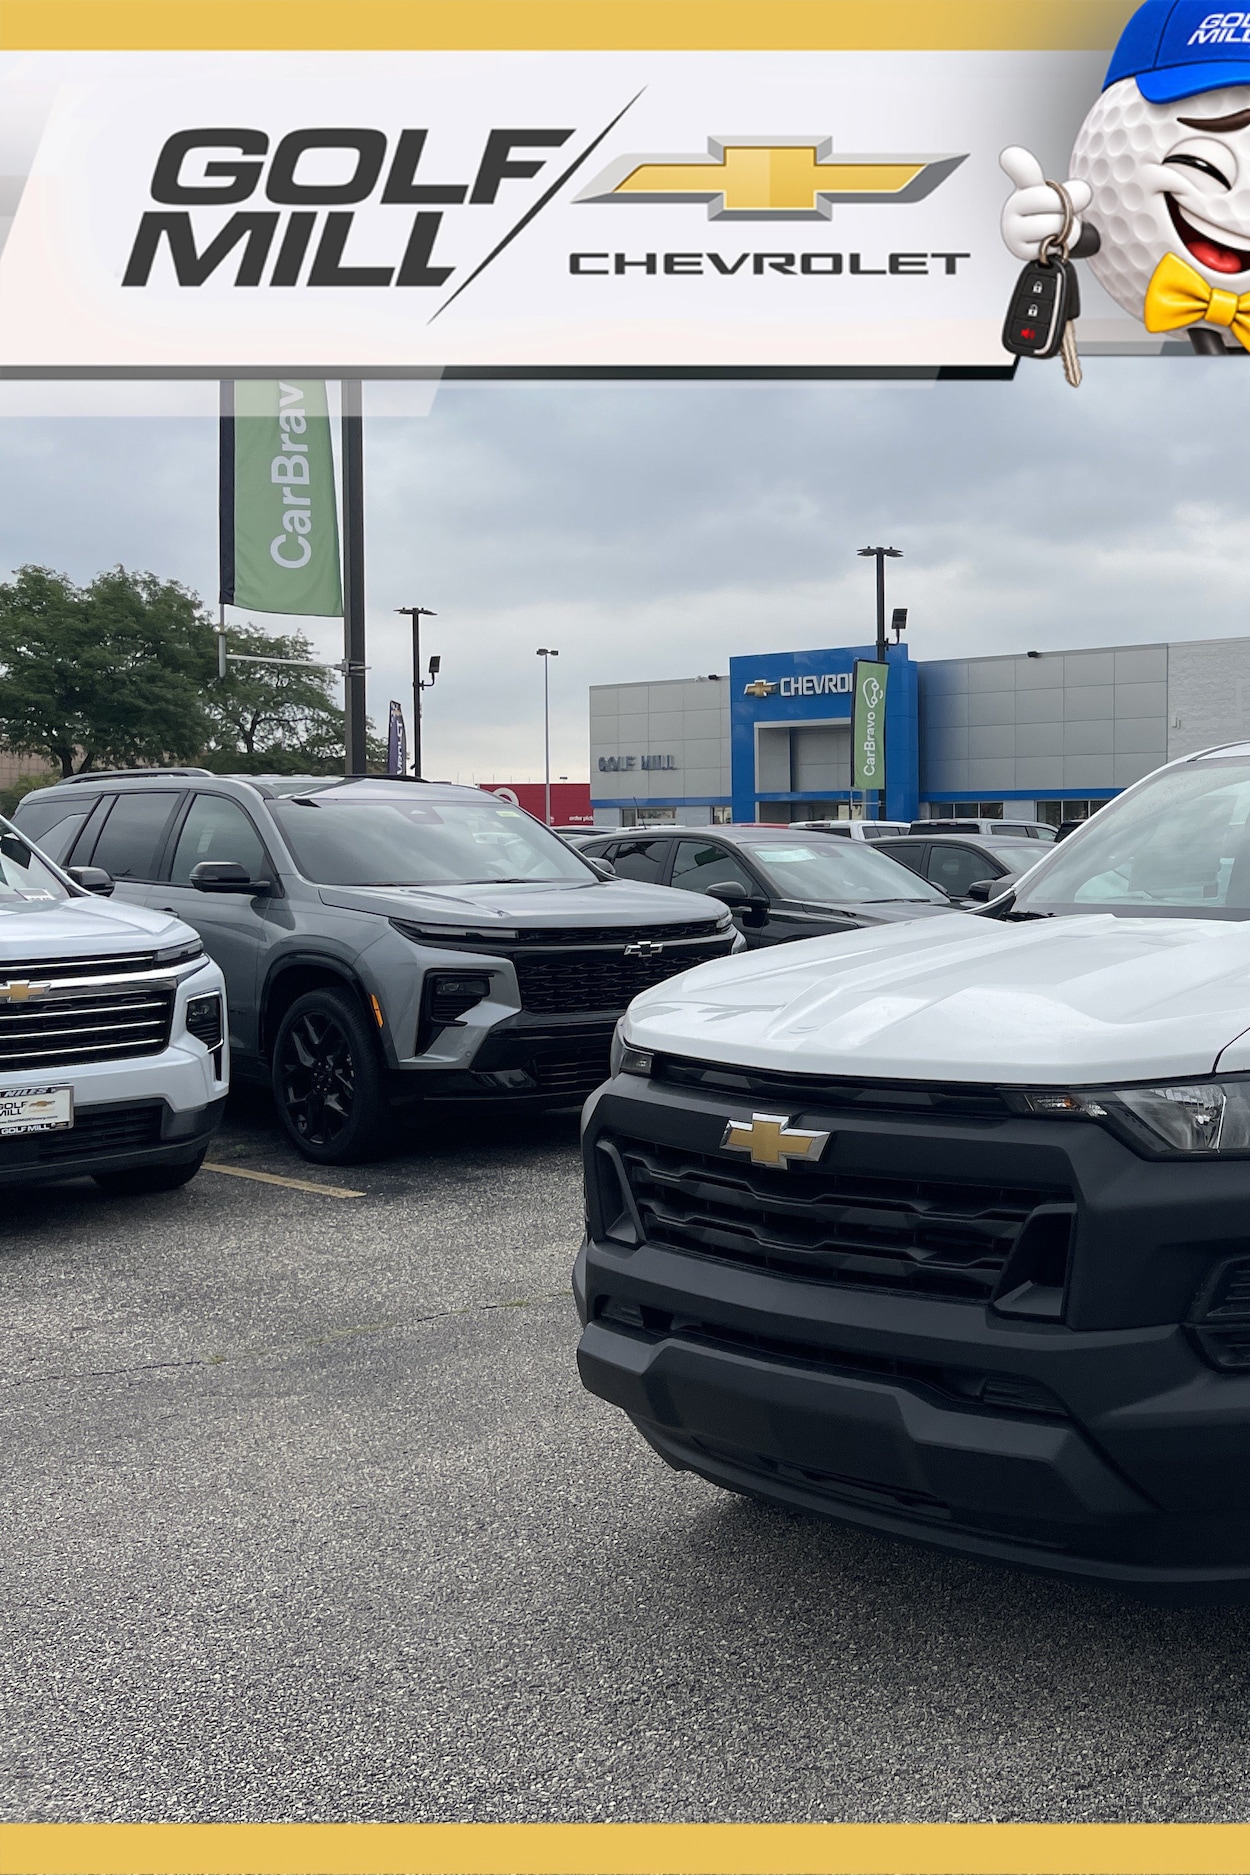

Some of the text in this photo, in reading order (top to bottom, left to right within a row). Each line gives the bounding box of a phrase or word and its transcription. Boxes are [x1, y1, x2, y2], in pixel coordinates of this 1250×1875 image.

[269, 380, 312, 569] CarBrav
[779, 672, 853, 697] CHEVRO
[863, 711, 876, 776] CarBravo
[598, 755, 677, 772] GOLF MILL
[1, 1123, 50, 1135] GOLF MILL
